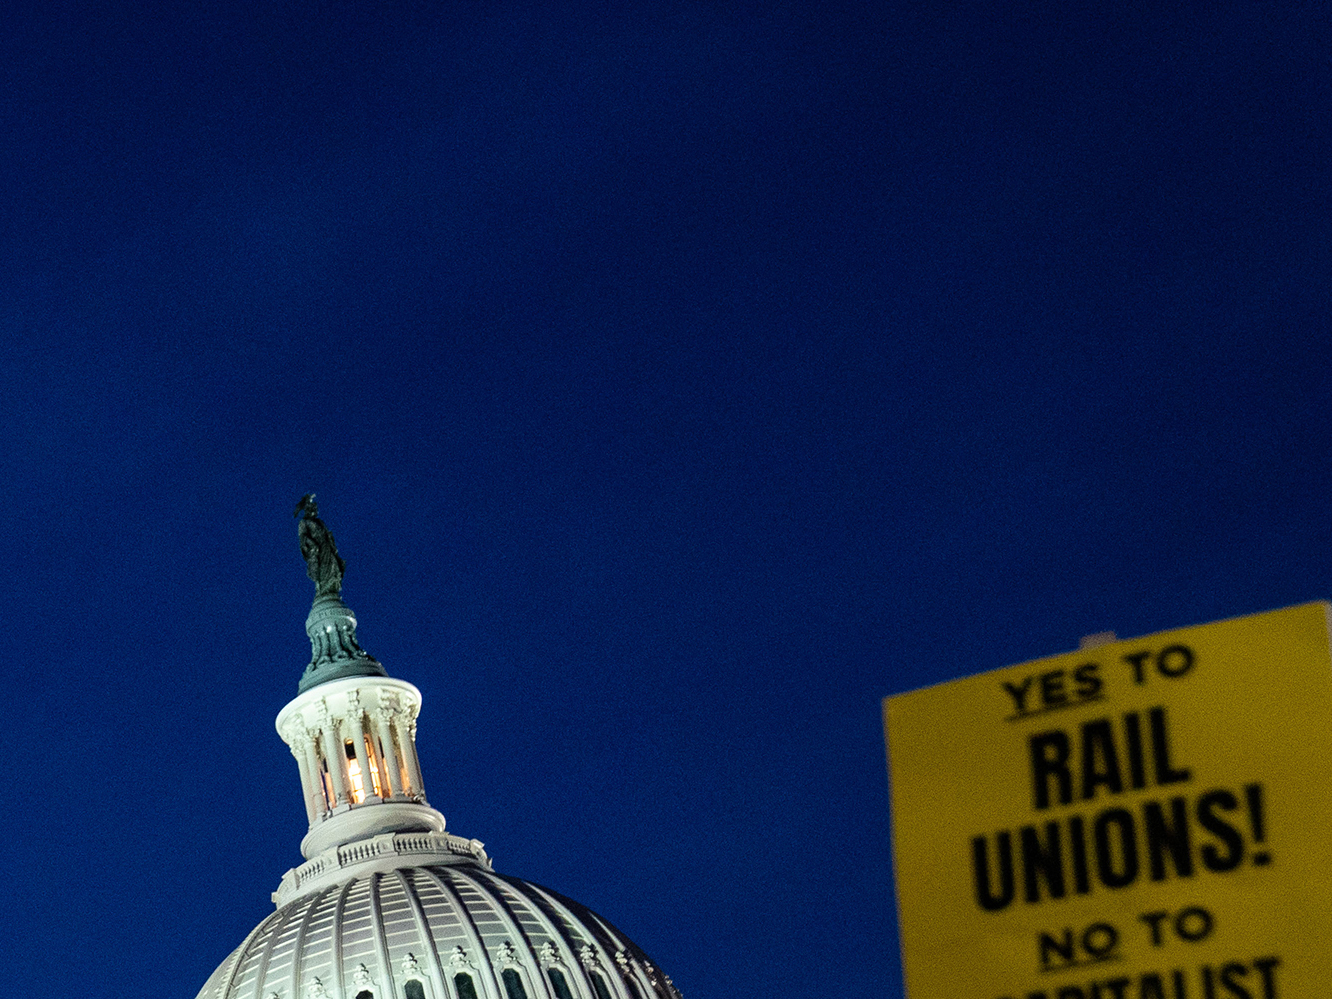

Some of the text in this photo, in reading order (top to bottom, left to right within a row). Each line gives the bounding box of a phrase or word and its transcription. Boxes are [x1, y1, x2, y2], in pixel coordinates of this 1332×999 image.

[1003, 643, 1197, 716] YES TO
[1028, 706, 1193, 812] RAIL
[971, 782, 1274, 913] UNIONS!
[1038, 905, 1217, 968] NO TO
